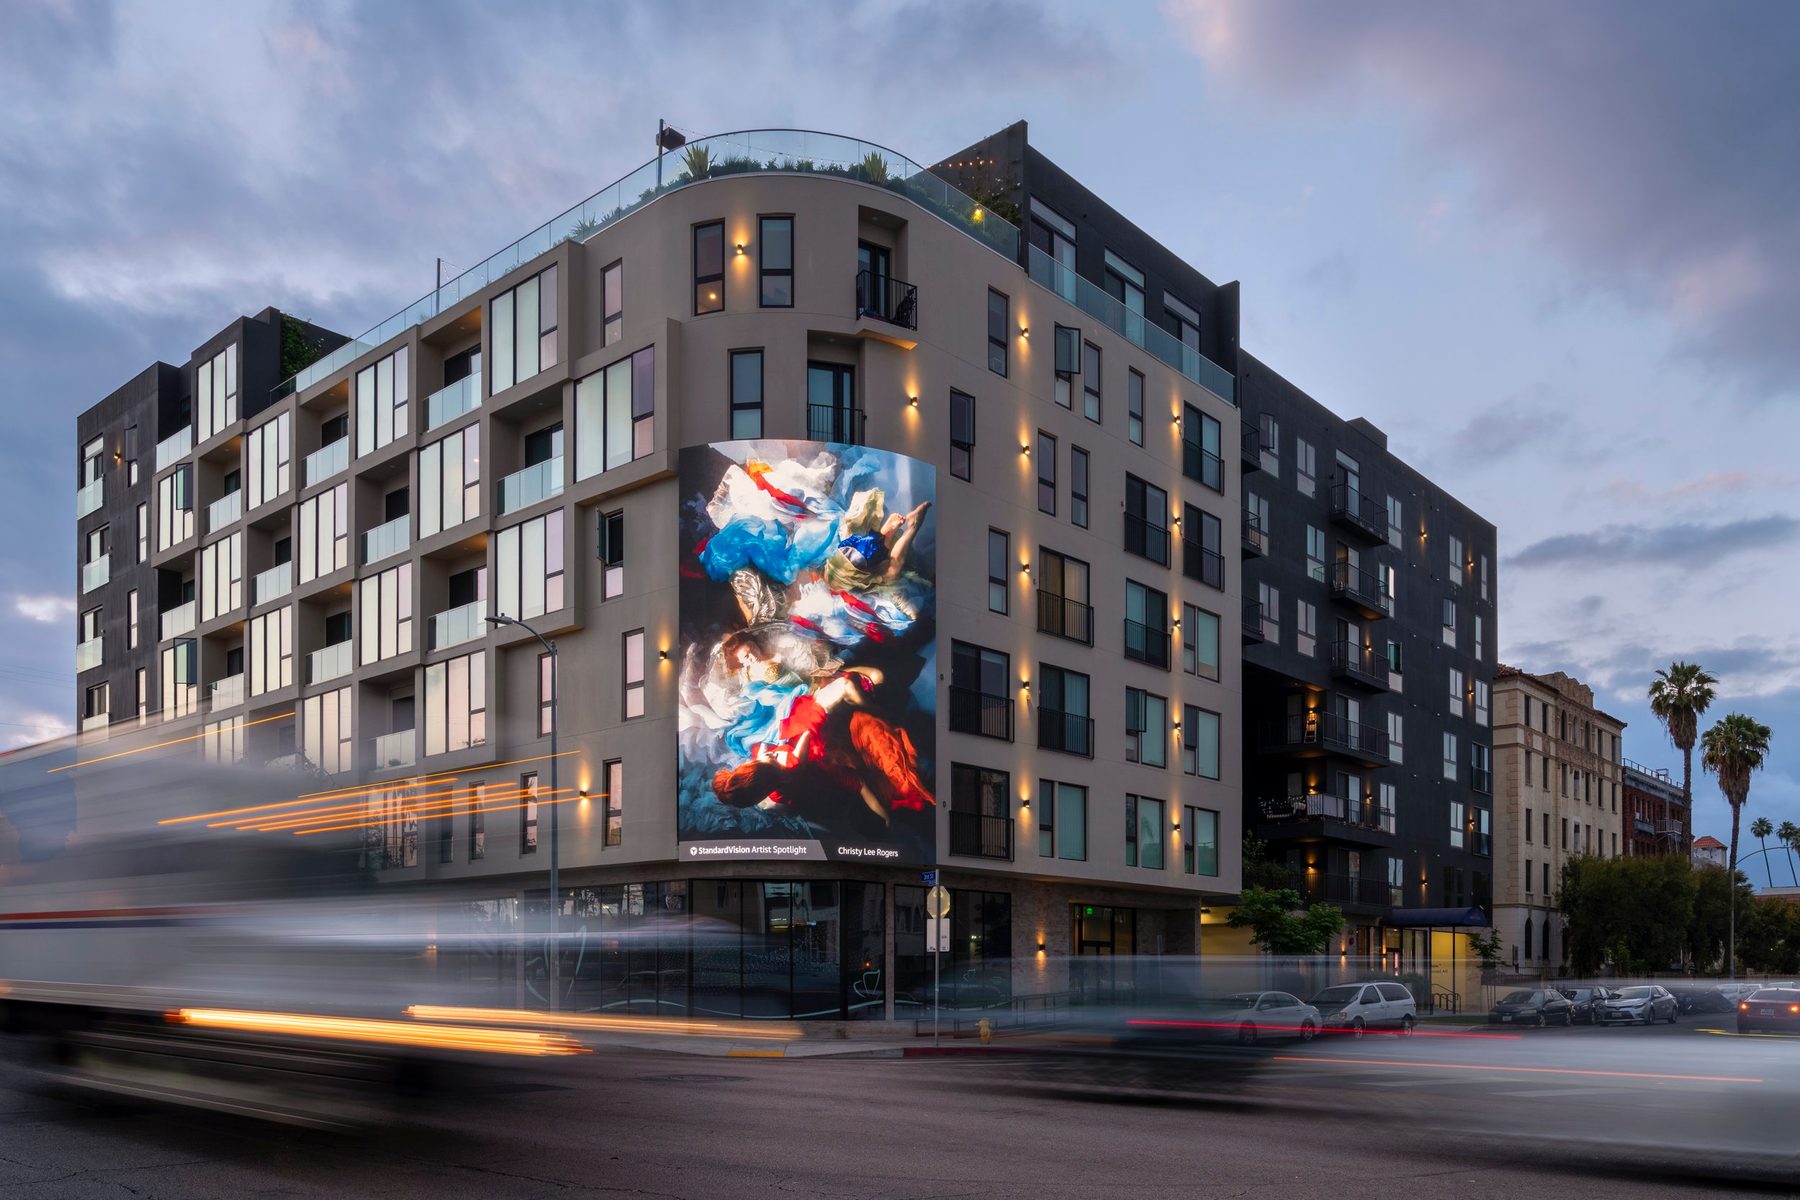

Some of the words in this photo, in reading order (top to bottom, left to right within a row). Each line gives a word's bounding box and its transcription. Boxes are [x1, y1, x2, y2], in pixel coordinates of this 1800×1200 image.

[698, 846, 750, 855] StandardVision
[751, 845, 772, 854] Artist
[772, 845, 807, 856] Spotlight
[838, 847, 863, 857] Christy
[863, 848, 876, 856] Lee
[876, 848, 899, 858] Rogers
